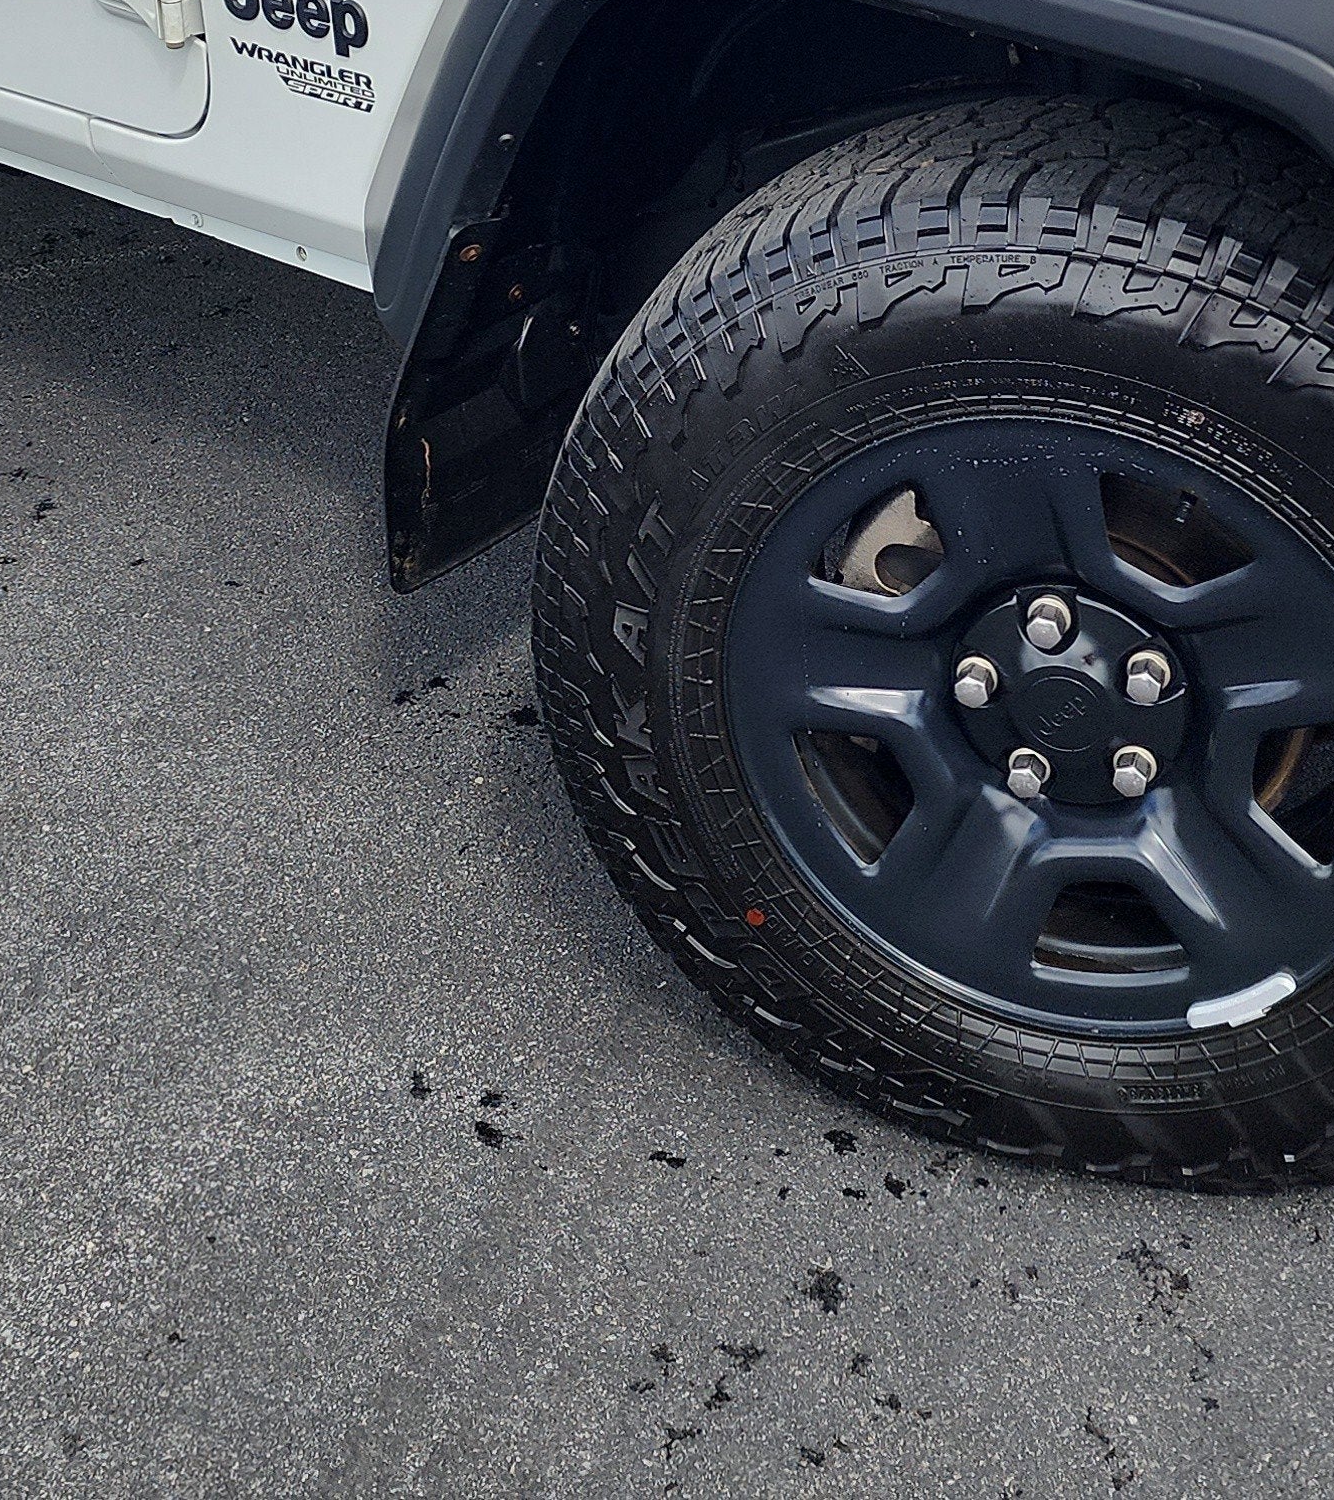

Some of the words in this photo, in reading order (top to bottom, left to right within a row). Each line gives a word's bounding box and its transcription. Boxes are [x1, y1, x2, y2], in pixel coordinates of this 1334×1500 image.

[229, 36, 374, 90] WRANGLER
[275, 65, 375, 99] UNLIMITED
[284, 78, 375, 112] SPORT
[878, 259, 925, 275] TRACTION
[932, 257, 939, 266] A
[949, 255, 1022, 265] TEMPERATURE
[1029, 255, 1037, 265] B
[1036, 696, 1087, 737] Jeep
